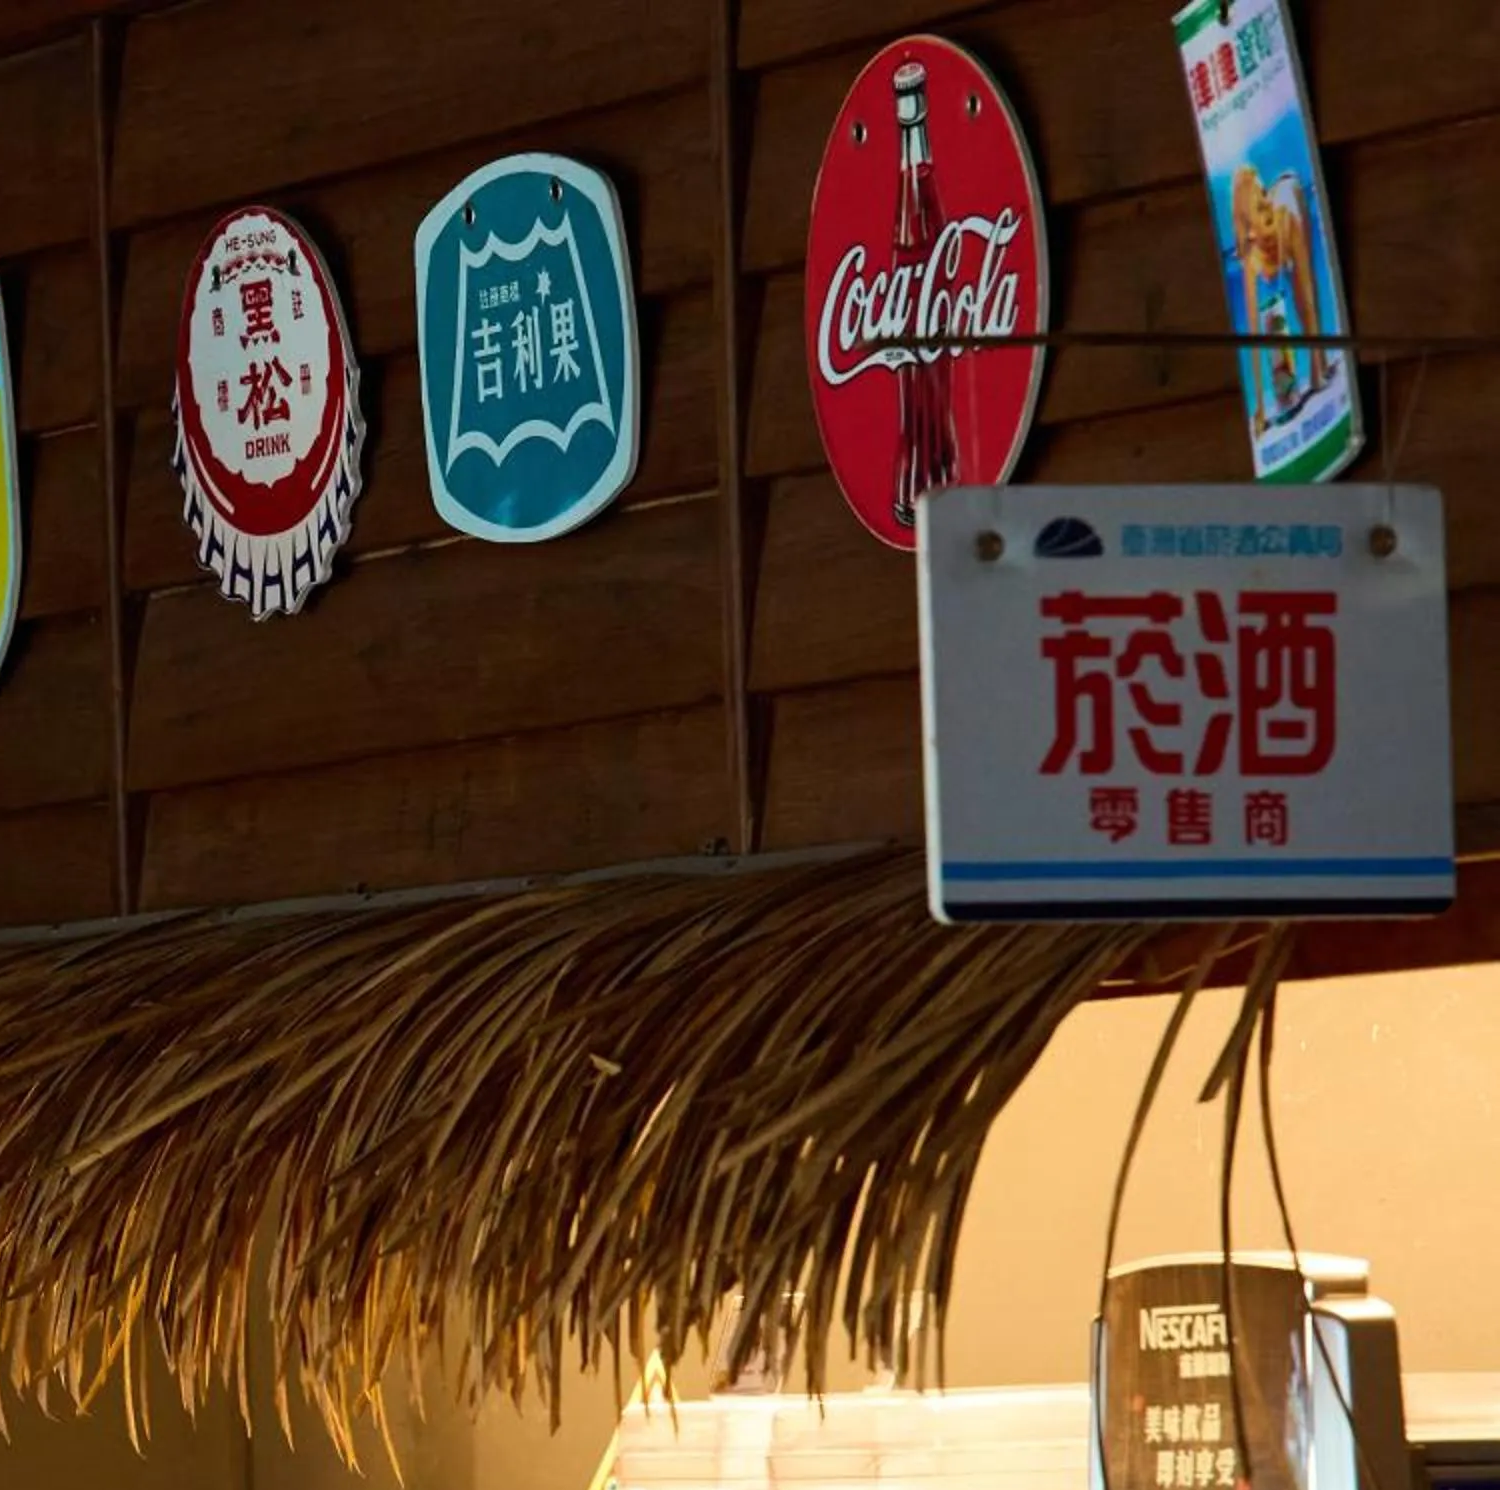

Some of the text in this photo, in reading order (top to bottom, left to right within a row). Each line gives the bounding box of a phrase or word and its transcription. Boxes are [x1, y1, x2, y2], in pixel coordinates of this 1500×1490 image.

[237, 278, 293, 432] 黑松
[471, 299, 582, 403] 吉利果
[817, 207, 1022, 385] Coca-Cola
[245, 432, 291, 460] DRINK
[1039, 590, 1338, 777] 菸酒
[1089, 787, 1289, 846] 零售商
